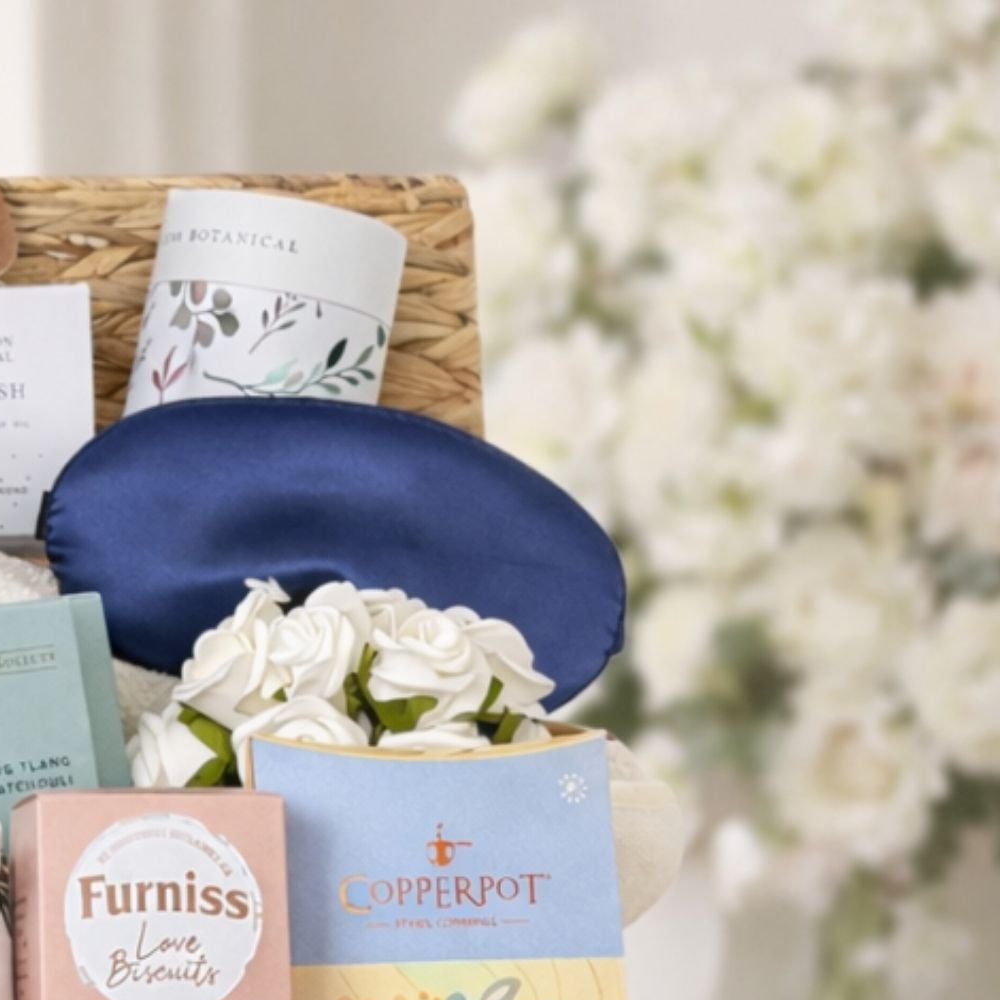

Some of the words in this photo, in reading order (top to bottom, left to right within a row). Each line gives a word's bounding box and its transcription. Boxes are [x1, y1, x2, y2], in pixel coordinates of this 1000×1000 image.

[78, 869, 250, 921] Furniss
[338, 872, 552, 915] COPPERPOT
[136, 919, 202, 962] Love
[106, 948, 222, 989] Biscuits
